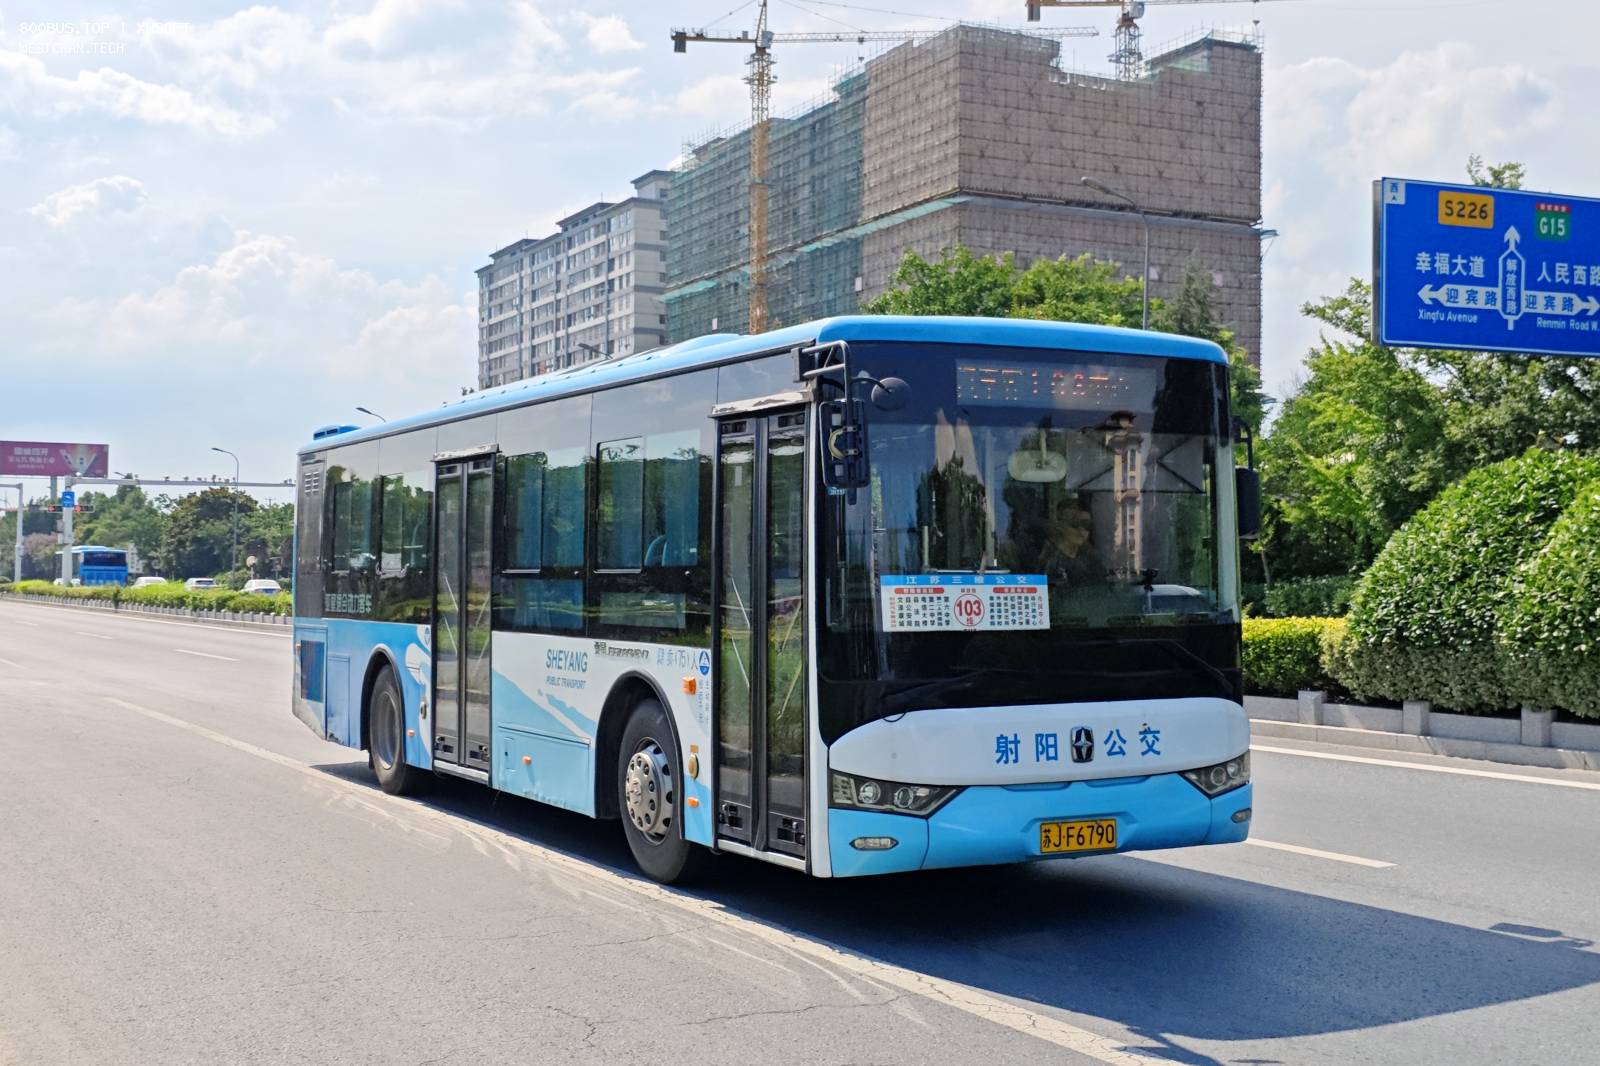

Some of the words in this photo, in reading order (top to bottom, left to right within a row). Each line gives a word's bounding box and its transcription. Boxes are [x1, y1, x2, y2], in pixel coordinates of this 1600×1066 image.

[1444, 200, 1488, 220] S226
[1539, 216, 1566, 237] G15
[1416, 251, 1485, 278] 幸福大道
[1446, 287, 1498, 307] 迎宾路
[1525, 293, 1575, 312] 迎宾路
[1418, 309, 1445, 323] Xingfu
[1446, 311, 1478, 323] Avenue
[1536, 317, 1566, 329] Renmin
[1569, 318, 1590, 331] Road
[956, 599, 982, 616] 103
[546, 648, 588, 673] SHEYANG
[995, 733, 1059, 765] 射阳
[1103, 726, 1161, 757] 公交
